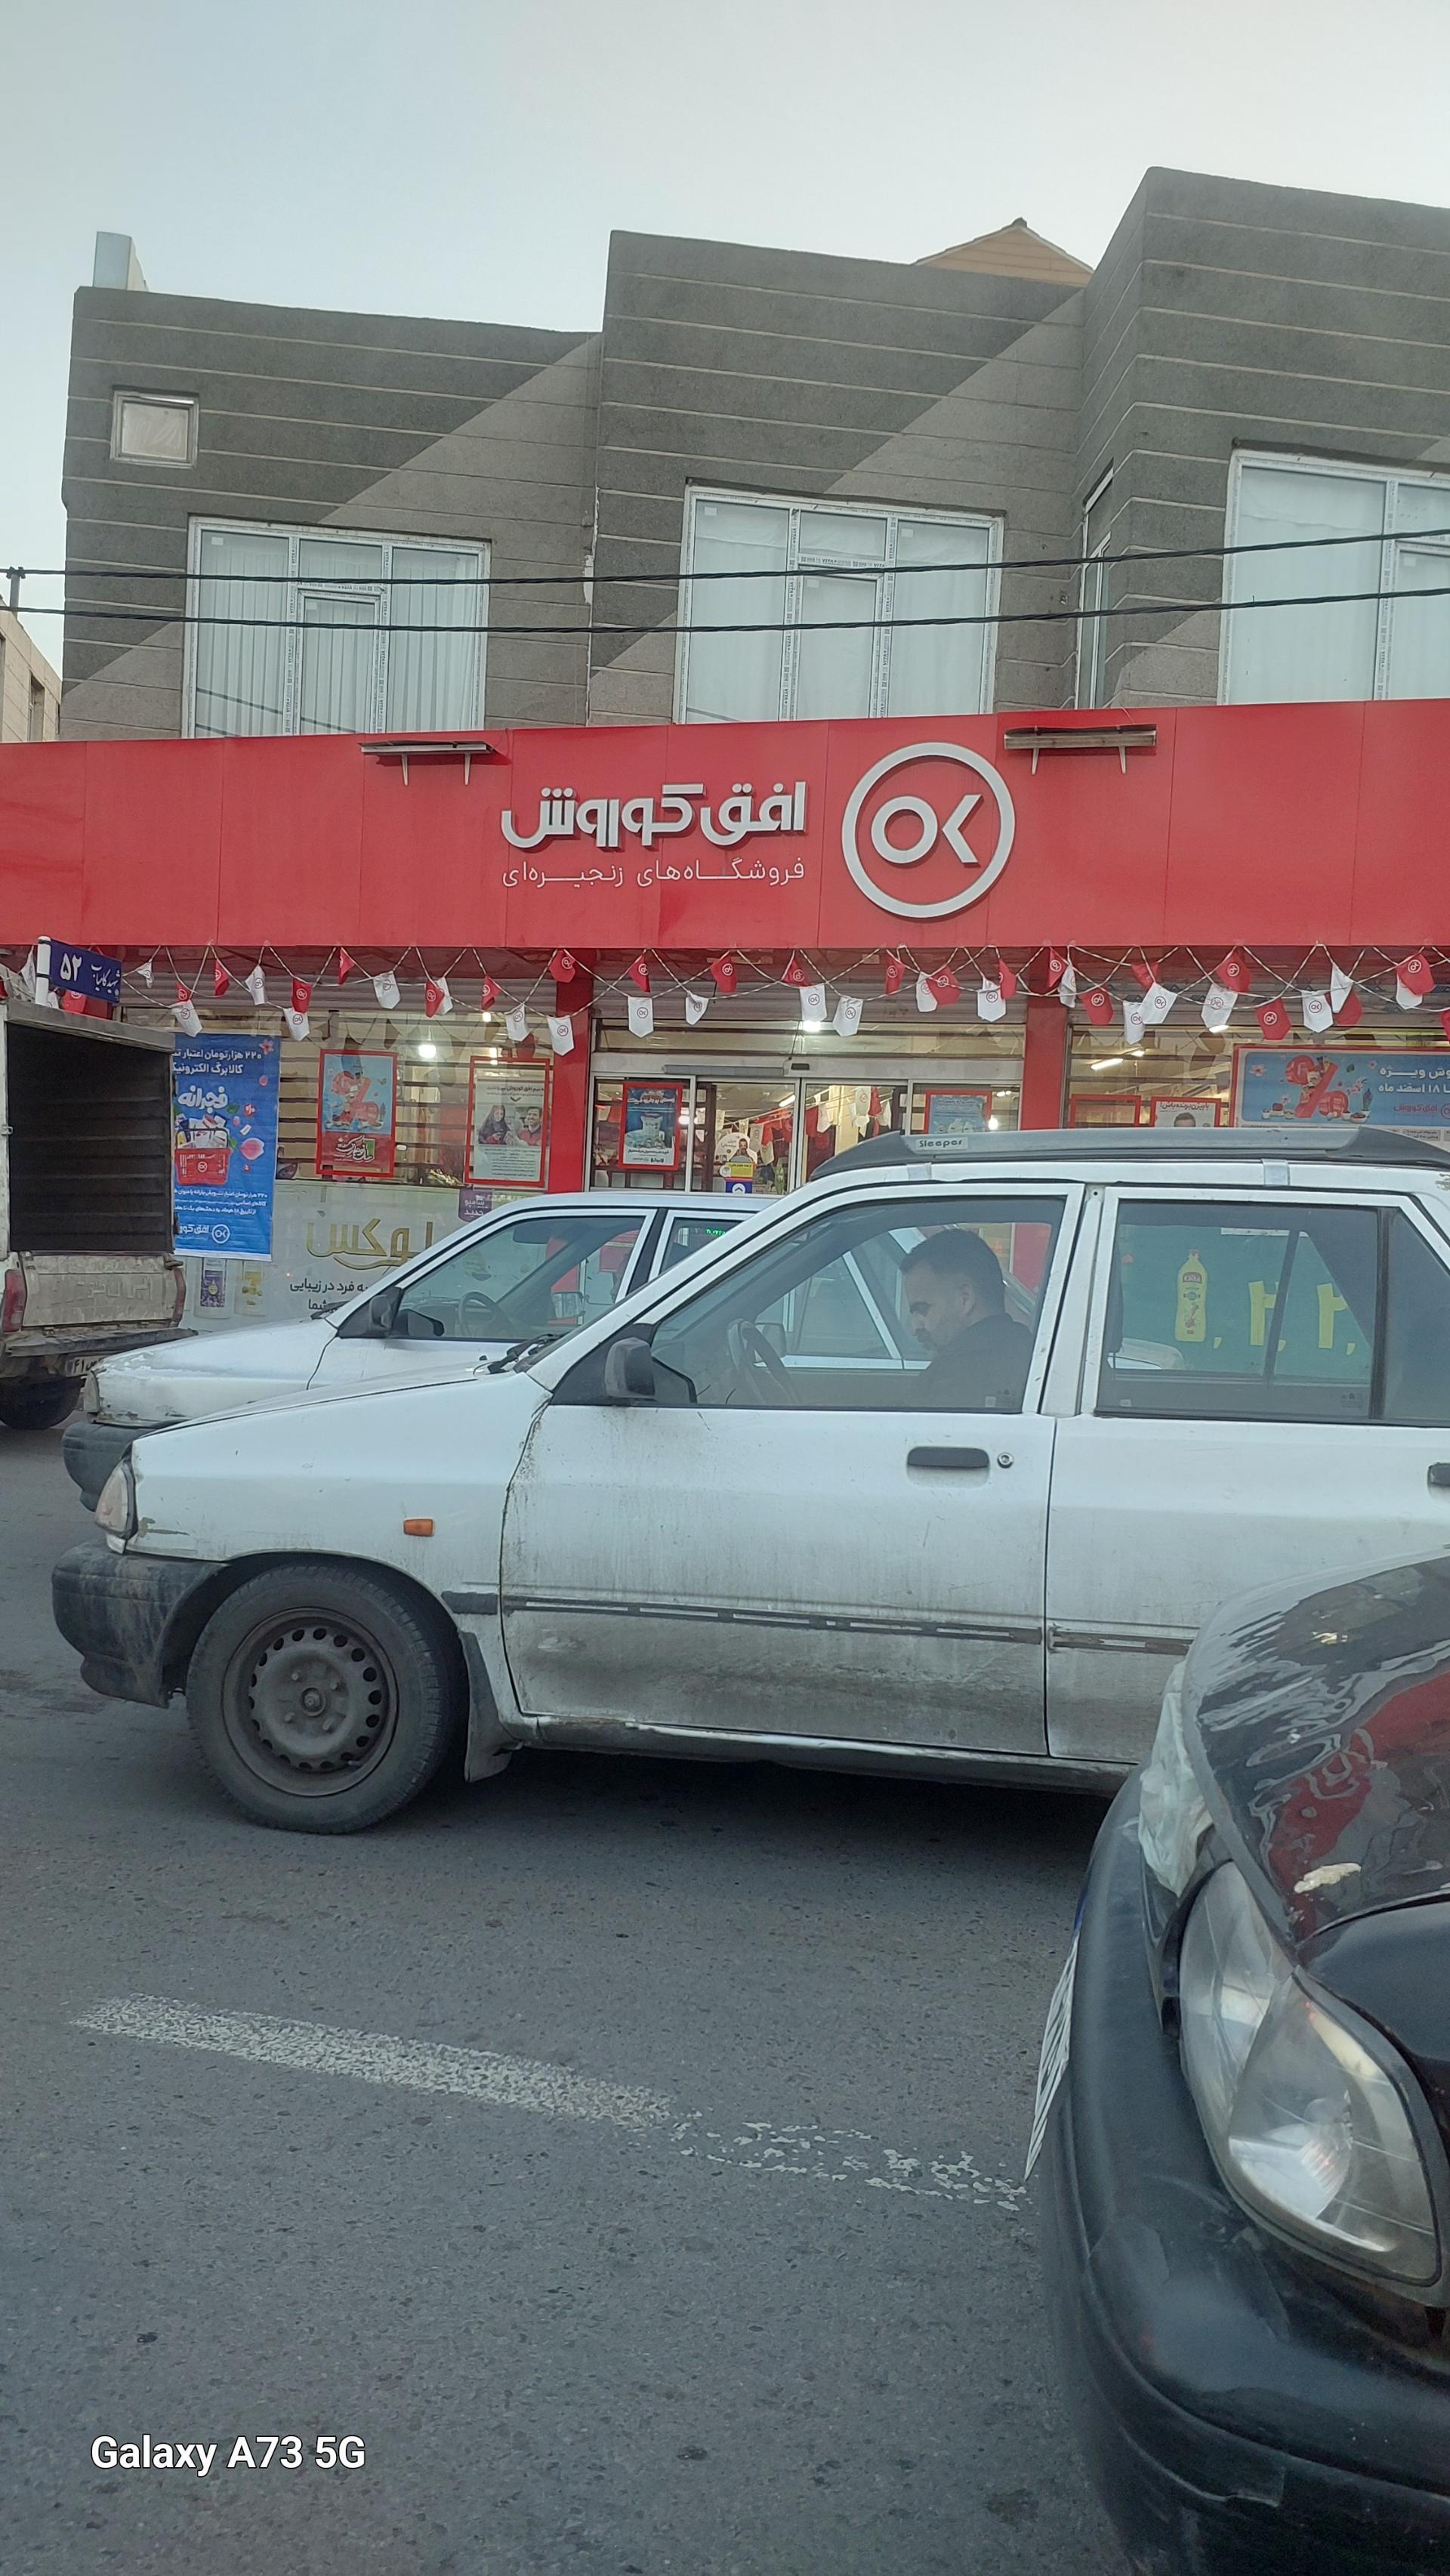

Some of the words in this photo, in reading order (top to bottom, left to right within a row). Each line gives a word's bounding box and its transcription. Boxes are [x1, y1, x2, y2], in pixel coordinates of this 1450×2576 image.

[501, 783, 705, 849] کوروش
[700, 780, 807, 846] افق
[871, 794, 983, 864] OK
[60, 953, 82, 981] ۵۲
[1380, 1064, 1426, 1079] ویژه
[1378, 1083, 1394, 1092] ماه
[1396, 1083, 1425, 1093] اسفند
[918, 1139, 963, 1148] Sleeper
[290, 1277, 322, 1293] زیبایی
[322, 1282, 335, 1293] در
[337, 1281, 355, 1295] فرد
